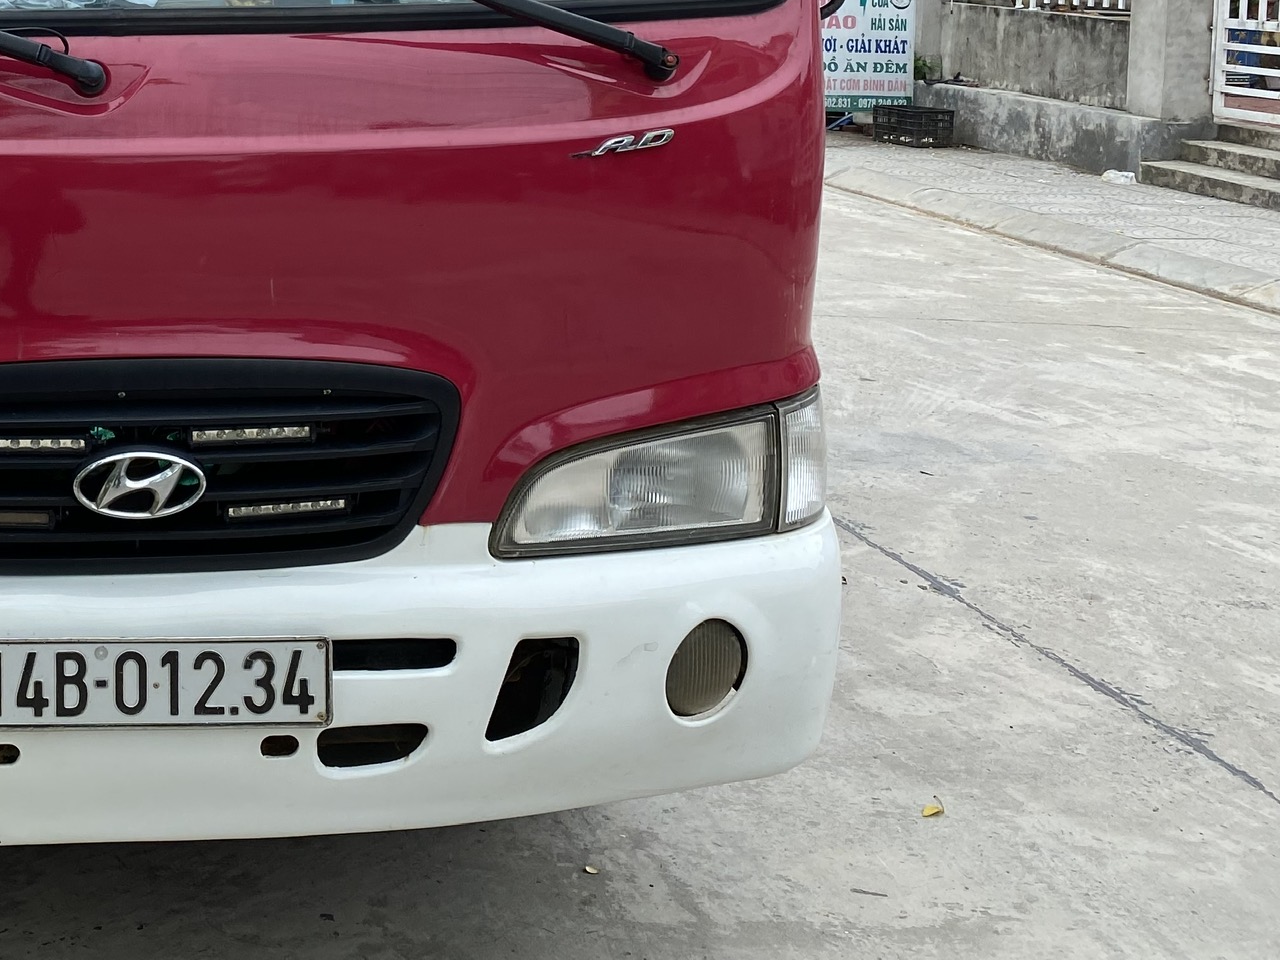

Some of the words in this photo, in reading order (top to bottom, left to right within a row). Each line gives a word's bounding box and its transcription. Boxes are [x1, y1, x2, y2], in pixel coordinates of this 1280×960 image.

[871, 14, 886, 31] HẢI
[888, 14, 907, 31] SẢN
[846, 33, 872, 53] GIẢI
[875, 36, 908, 54] KHÁT
[843, 58, 868, 73] ĂN
[872, 59, 908, 74] ĐÊM
[840, 77, 860, 91] CƠM
